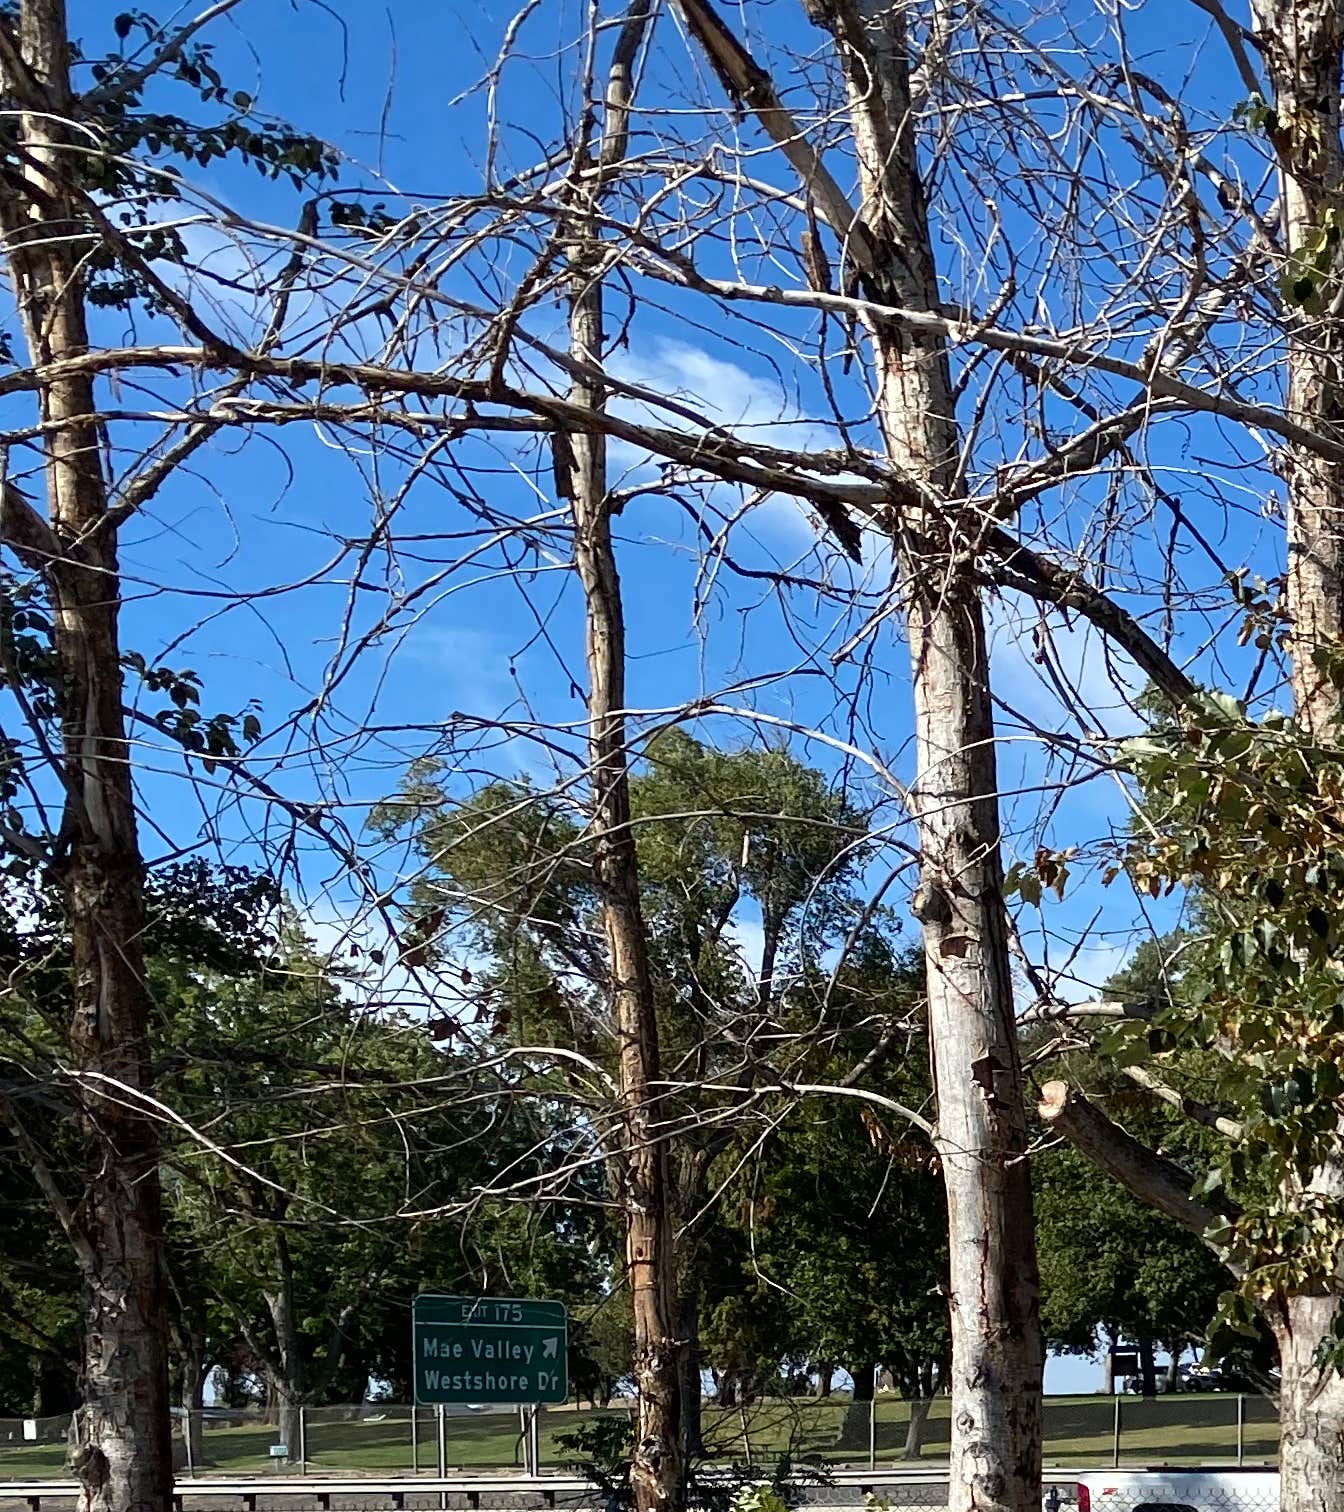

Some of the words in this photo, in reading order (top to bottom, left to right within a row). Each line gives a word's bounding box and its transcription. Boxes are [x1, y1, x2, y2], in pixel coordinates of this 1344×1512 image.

[494, 1303, 523, 1322] 175
[423, 1337, 463, 1358] Mae
[471, 1339, 534, 1365] Valley
[424, 1370, 529, 1390] Westshore
[538, 1371, 559, 1391] Dr
